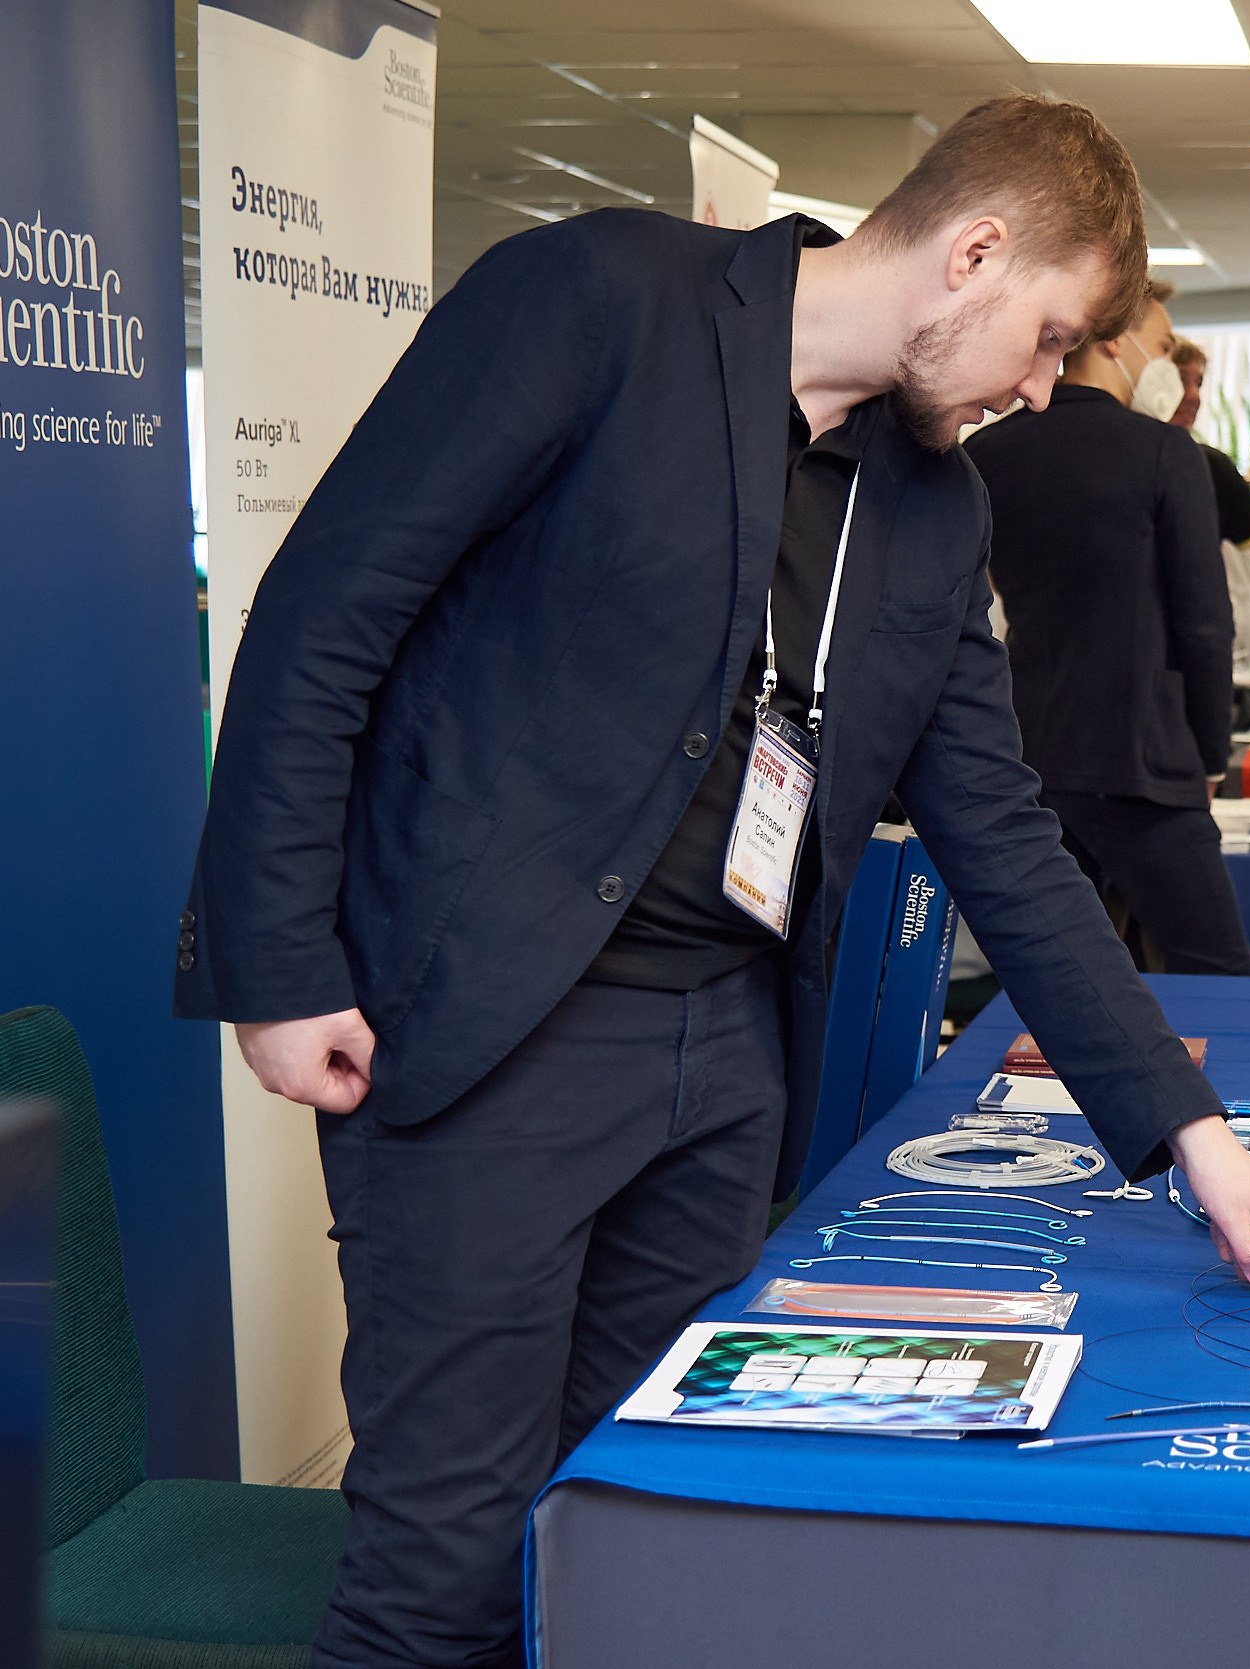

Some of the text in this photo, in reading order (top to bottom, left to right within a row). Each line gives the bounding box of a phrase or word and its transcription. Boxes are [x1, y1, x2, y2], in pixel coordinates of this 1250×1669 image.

[231, 165, 323, 236] Энергия,
[0, 209, 101, 291] oston
[233, 247, 430, 318] которая Вам нужна
[32, 407, 100, 445] science
[105, 410, 127, 446] for
[289, 420, 301, 443] XL
[236, 459, 269, 478] 50 Вт
[753, 754, 786, 790] ВСТРЕЧИ
[789, 789, 806, 807] 2021
[751, 801, 786, 839] Анатолий
[900, 874, 928, 949] Scientific
[914, 886, 936, 933] Boston
